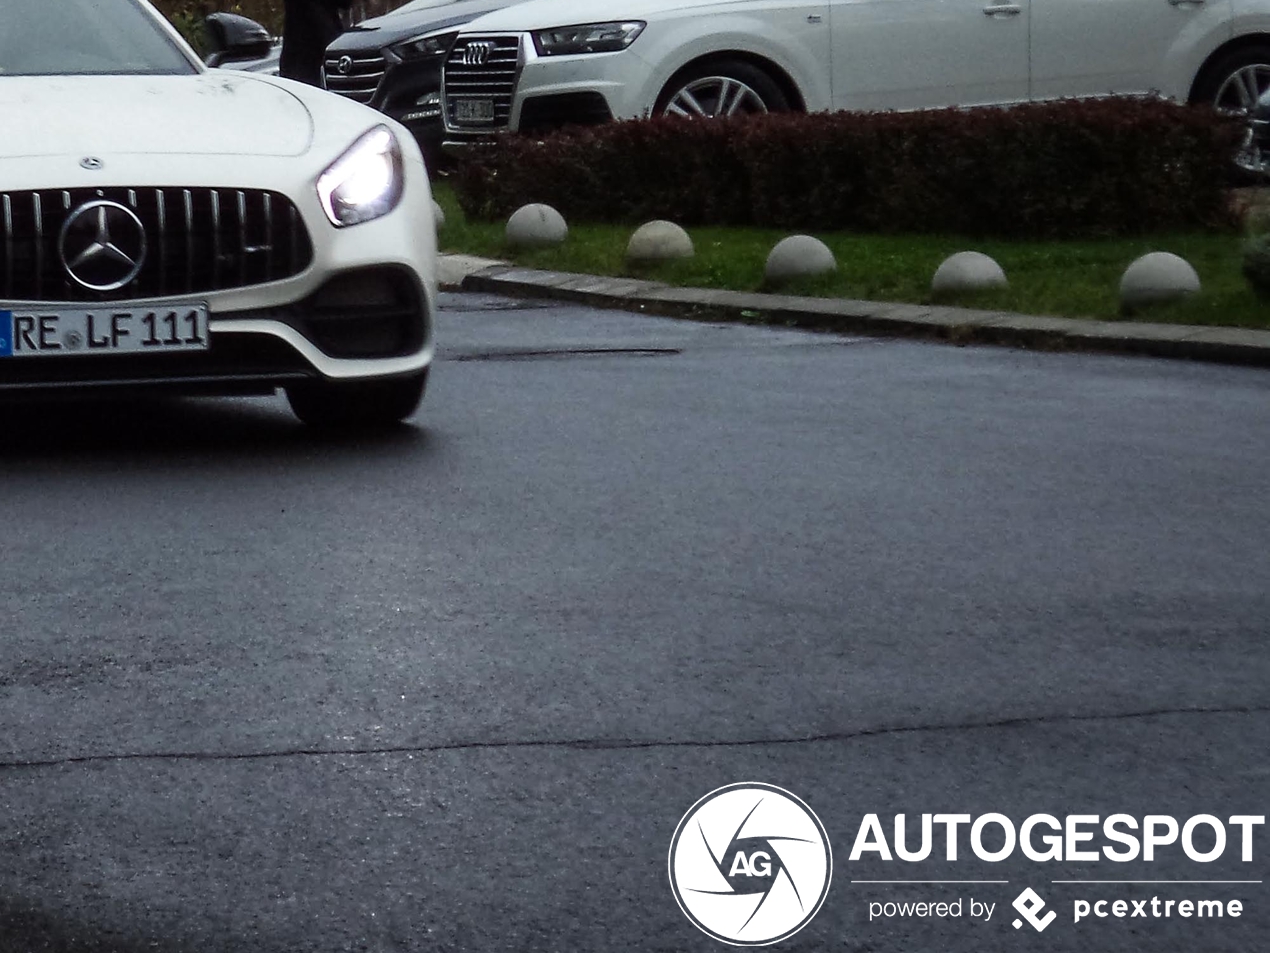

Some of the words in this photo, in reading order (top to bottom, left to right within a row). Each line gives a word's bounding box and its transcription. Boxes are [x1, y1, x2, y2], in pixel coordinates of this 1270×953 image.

[14, 316, 60, 350] RE
[87, 313, 132, 348] LF
[142, 310, 203, 346] 111
